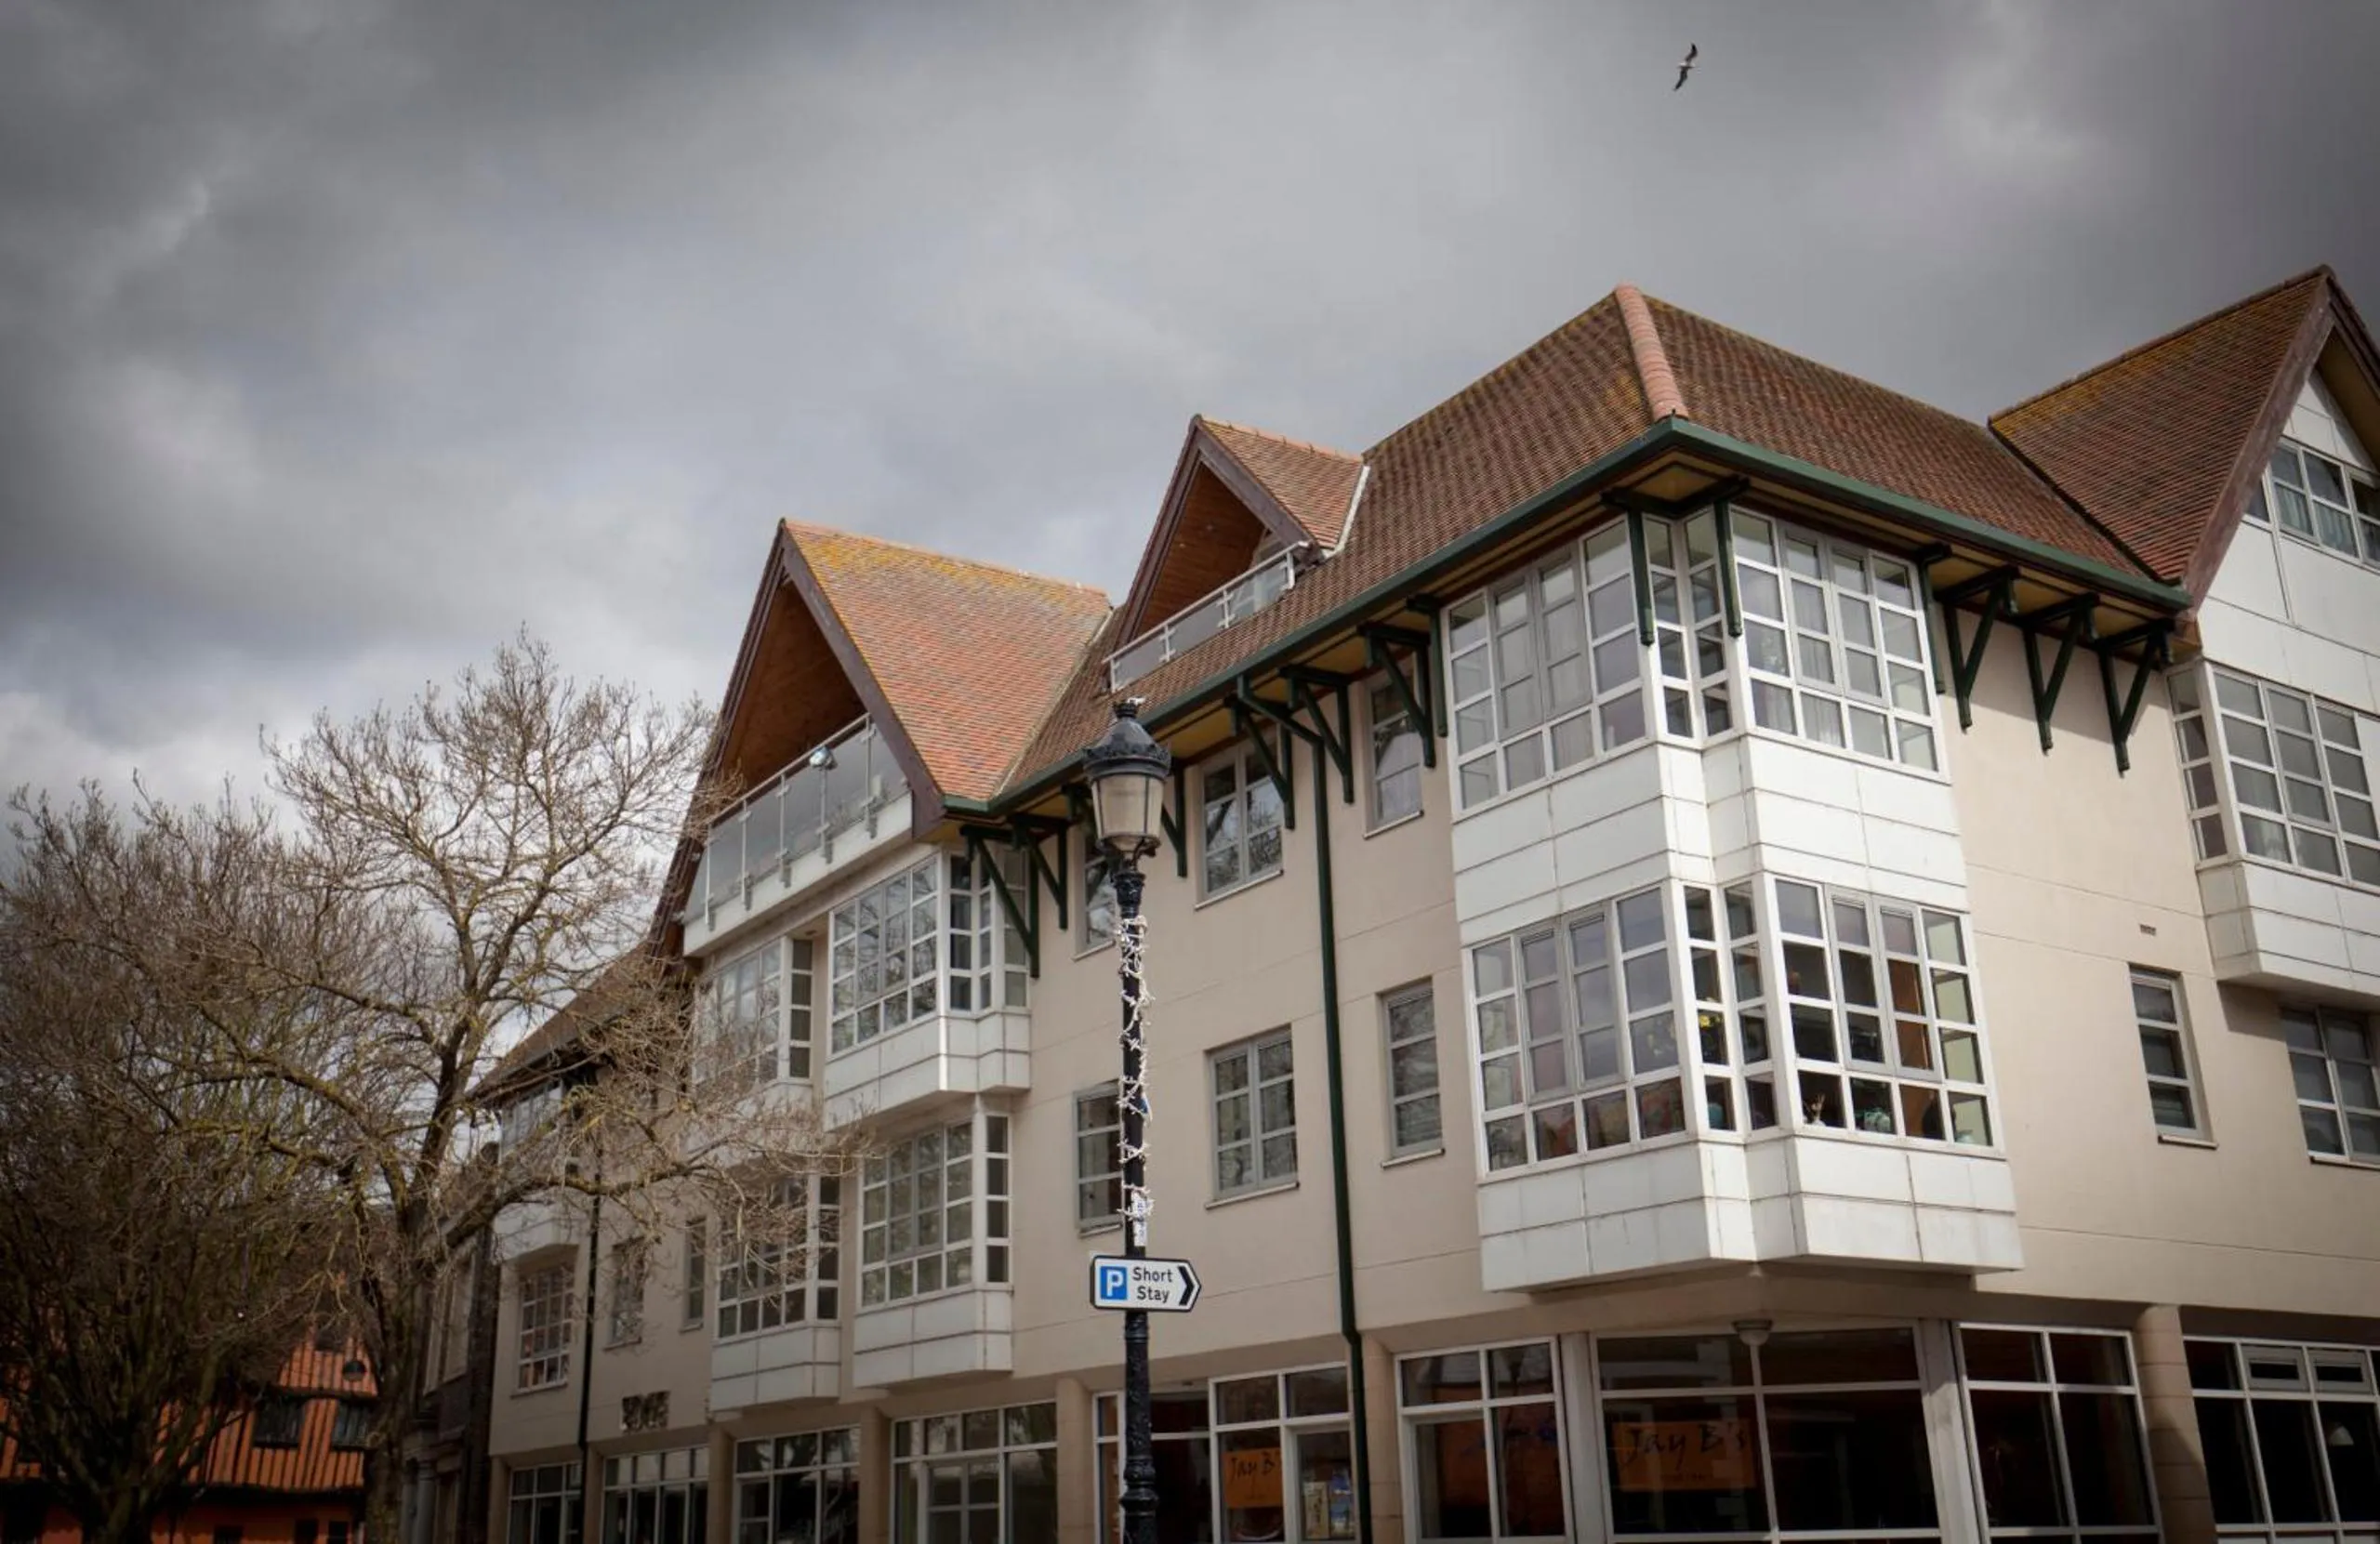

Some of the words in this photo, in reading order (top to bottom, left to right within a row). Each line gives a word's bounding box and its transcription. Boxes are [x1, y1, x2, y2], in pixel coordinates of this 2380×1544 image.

[1106, 1270, 1124, 1297] P
[1132, 1266, 1172, 1282] Short
[1136, 1286, 1170, 1303] Stay
[1621, 1429, 1686, 1472] Jay
